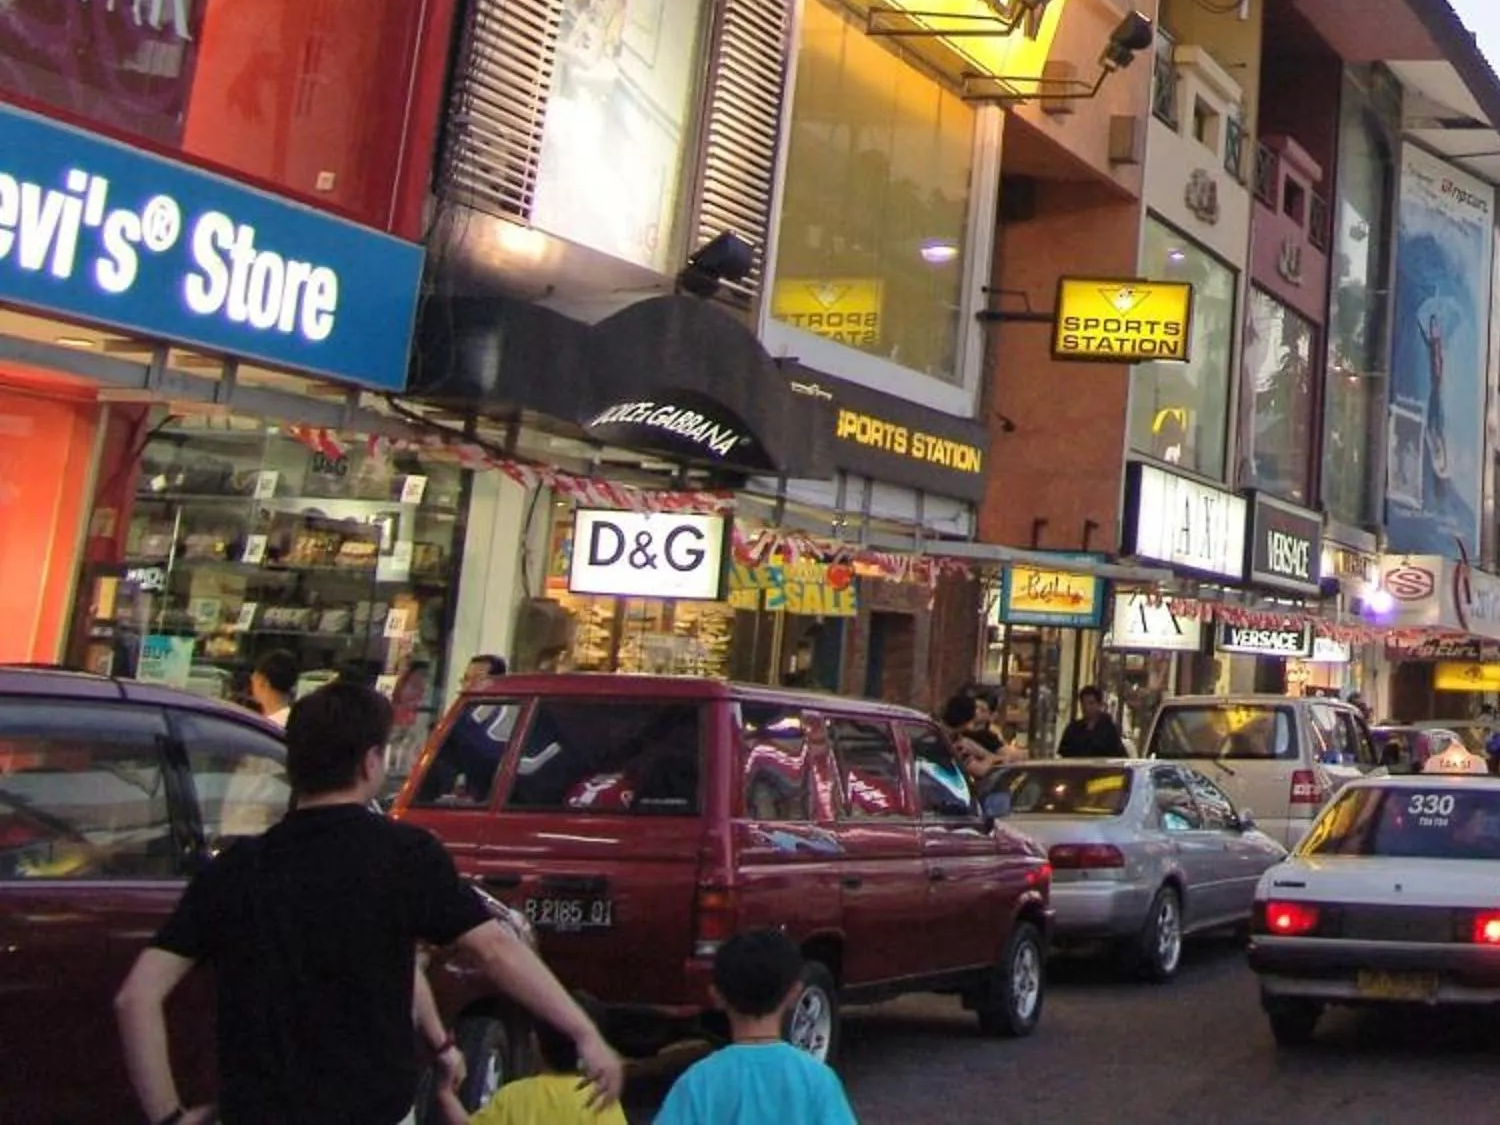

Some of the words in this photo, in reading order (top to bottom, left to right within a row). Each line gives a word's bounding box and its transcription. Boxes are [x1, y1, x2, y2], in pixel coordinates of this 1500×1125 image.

[185, 211, 338, 341] Store
[1063, 315, 1181, 337] SPORTS
[1062, 335, 1180, 355] STATION
[911, 431, 983, 474] STATION
[587, 518, 706, 573] D&G
[1267, 530, 1311, 579] VERSACE
[1231, 628, 1299, 650] VERSACE
[1407, 794, 1455, 816] 330
